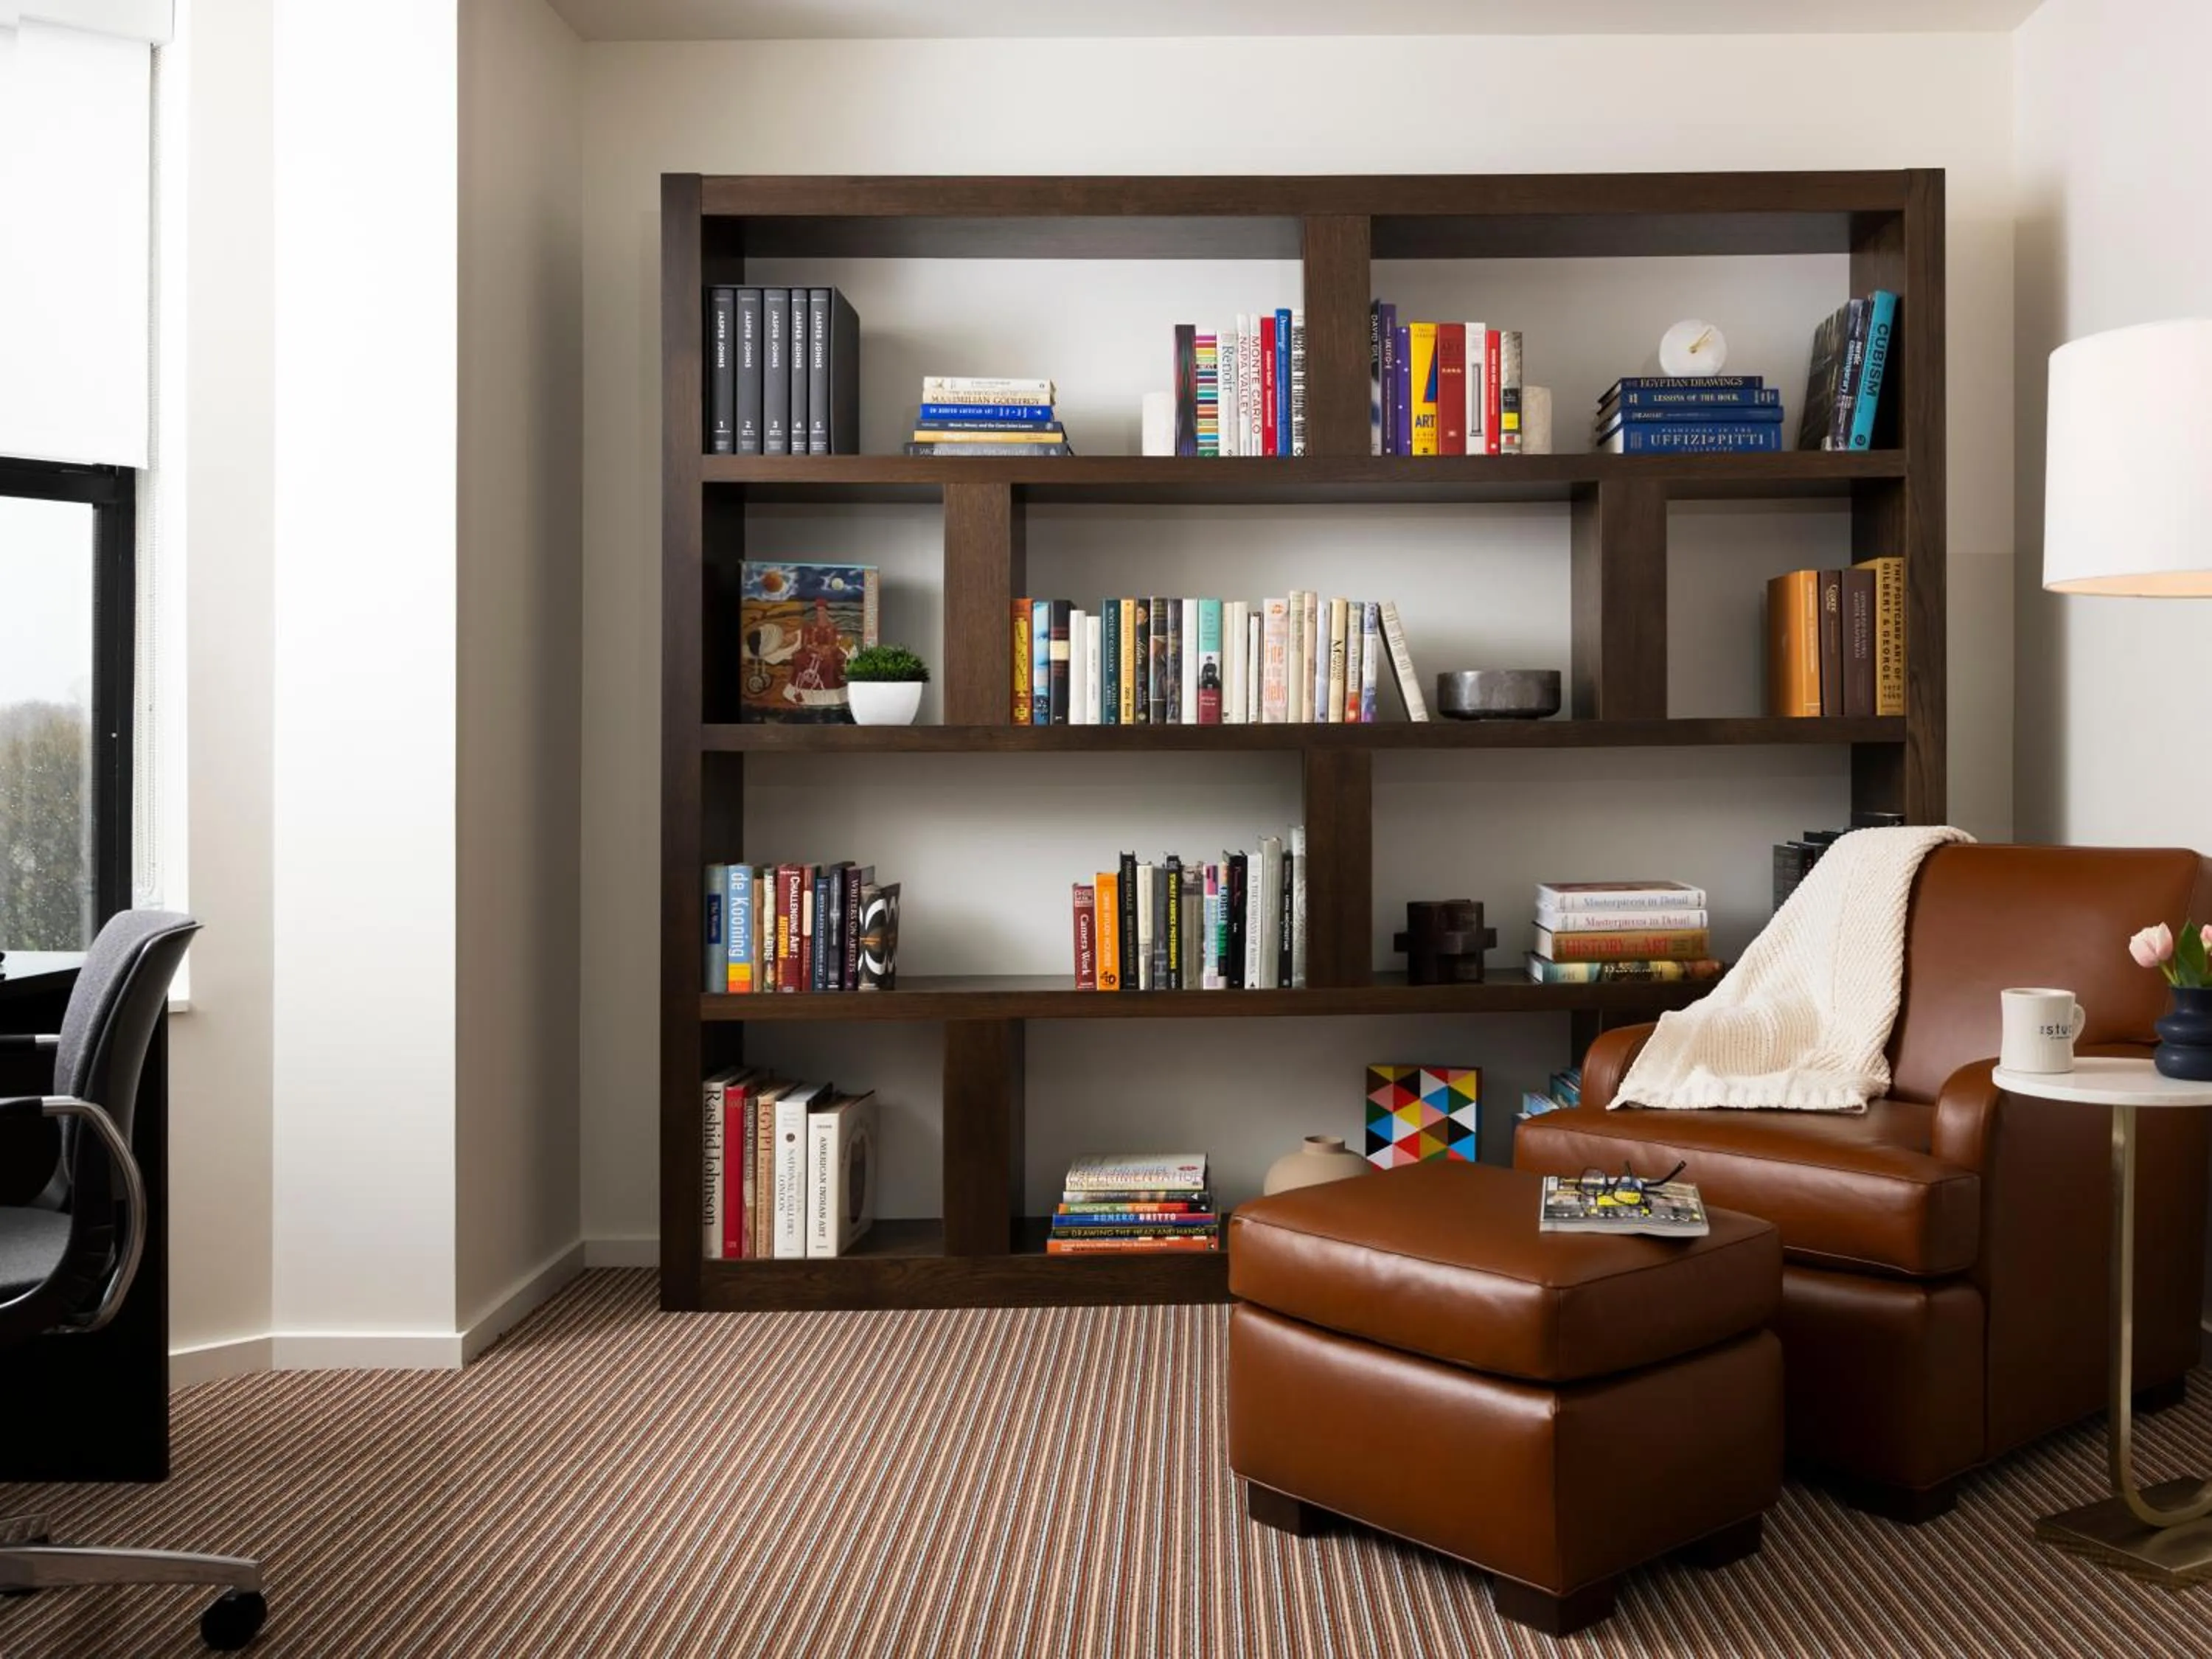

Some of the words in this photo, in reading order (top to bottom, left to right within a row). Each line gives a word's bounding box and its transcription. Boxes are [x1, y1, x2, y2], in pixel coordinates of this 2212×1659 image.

[717, 310, 726, 339] JASPER
[744, 310, 752, 339] JASPER
[1371, 315, 1380, 341] DAVID
[717, 341, 726, 368] JOHNS
[744, 341, 752, 368] JOHNS
[1239, 336, 1248, 369] NAPA
[1251, 335, 1262, 383] MONTE
[1840, 339, 1856, 394] contemporary
[1853, 341, 1863, 366] nordic
[1865, 322, 1889, 397] CUBISM
[1222, 345, 1236, 392] Renoir
[1640, 378, 1688, 388] EGYPTIAN
[1690, 377, 1744, 387] DRAWINGS
[1239, 372, 1248, 417] VALLEY
[1700, 394, 1715, 402] THE
[1251, 389, 1262, 435] CARLO
[1415, 414, 1435, 428] ART
[1650, 434, 1705, 445] UFFIZI
[1717, 434, 1764, 445] PITTI
[1893, 667, 1901, 681] OF
[731, 872, 749, 890] de
[790, 876, 800, 933] CHALLENGING
[849, 879, 858, 919] WRITERS
[1584, 897, 1646, 909] Masterpieces
[1647, 897, 1657, 907] in
[1660, 895, 1688, 906] Detail
[728, 897, 750, 957] Kooning
[778, 915, 789, 959] ARTFORUM
[849, 921, 858, 935] ON
[1080, 914, 1090, 950] Camera
[1585, 917, 1646, 930] Masterpieces
[1649, 917, 1659, 927] in
[1661, 915, 1690, 926] Detail
[790, 935, 799, 953] ART
[849, 937, 857, 973] ARTISTS
[1565, 938, 1623, 953] HISTORY
[1644, 937, 1668, 953] ART
[1081, 950, 1091, 975] Work
[703, 1088, 721, 1150] Rashid
[759, 1103, 772, 1154] EGYPT
[787, 1148, 796, 1192] NATIONAL
[818, 1136, 827, 1183] AMERICAN
[703, 1154, 720, 1225] Johnson
[778, 1175, 786, 1211] LONDON
[818, 1186, 827, 1219] INDIAN
[818, 1220, 827, 1238] ART
[1093, 1214, 1135, 1222] ROMERO
[1139, 1213, 1176, 1221] BRITTO
[1071, 1229, 1114, 1237] DRAWING
